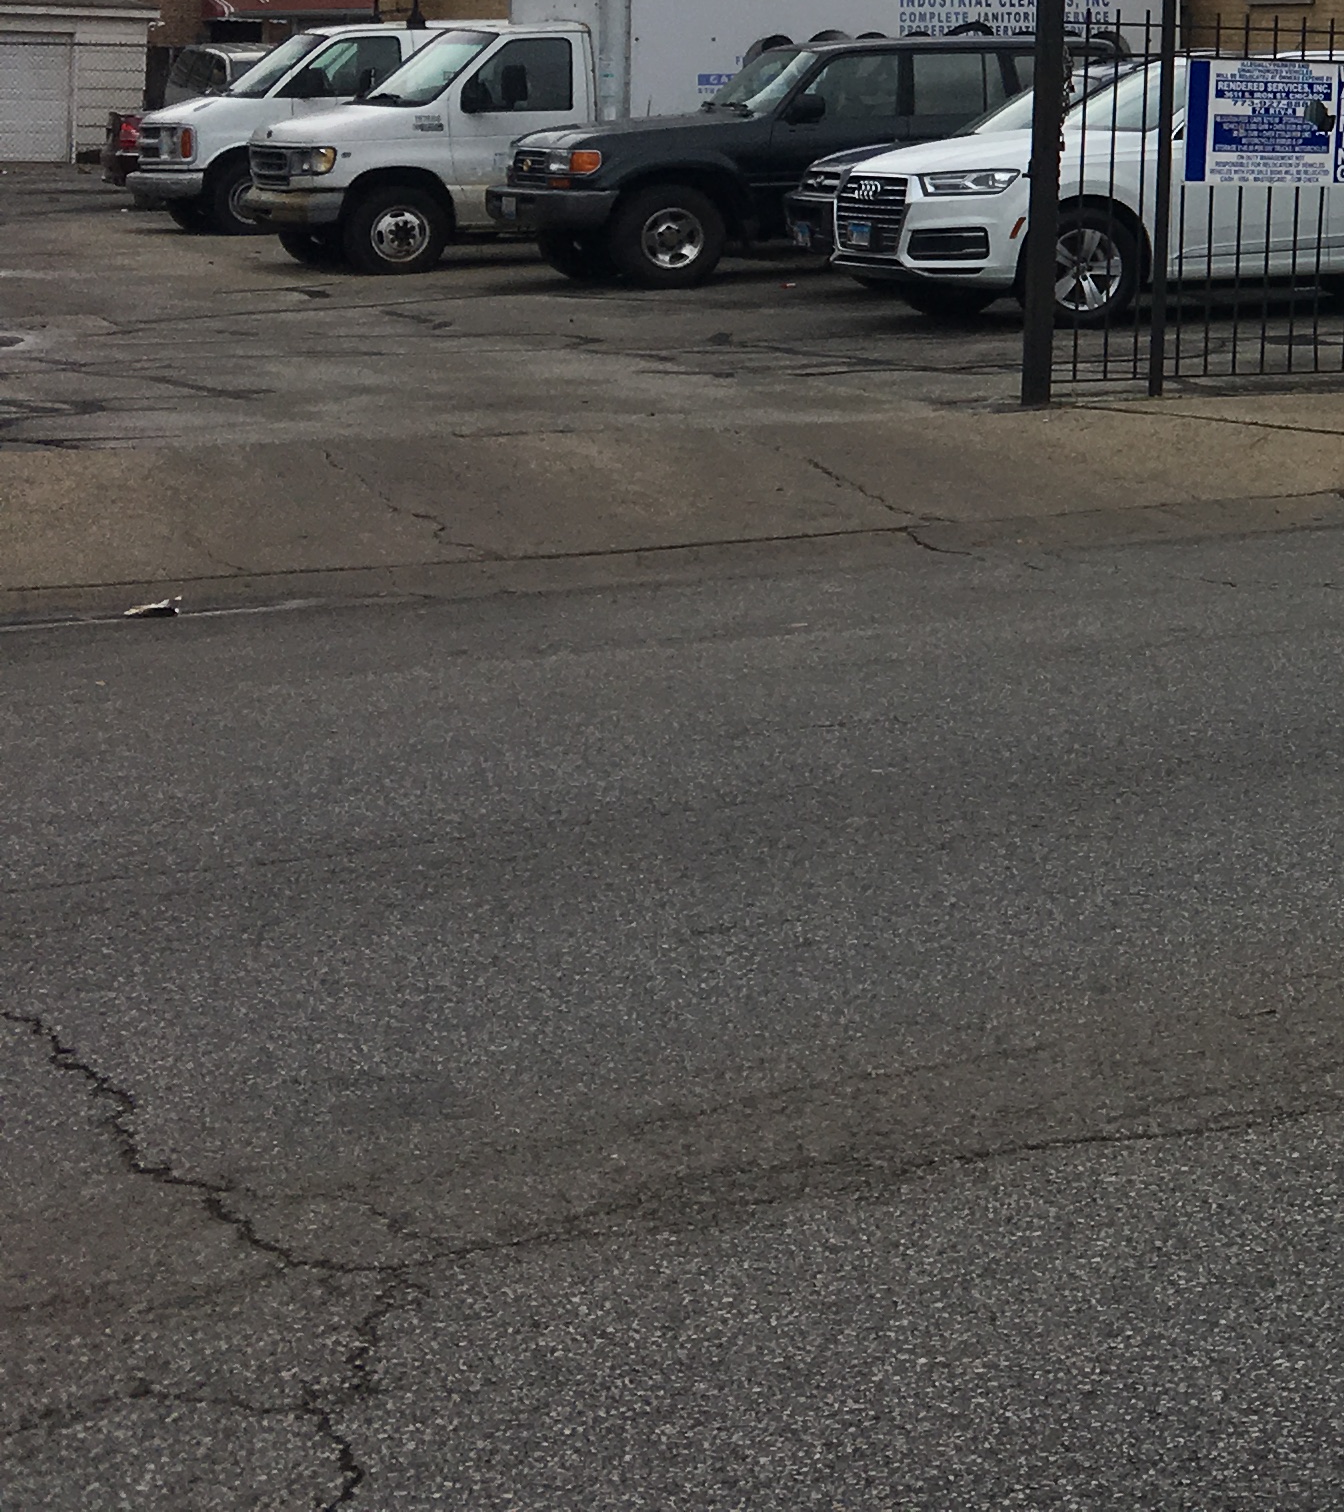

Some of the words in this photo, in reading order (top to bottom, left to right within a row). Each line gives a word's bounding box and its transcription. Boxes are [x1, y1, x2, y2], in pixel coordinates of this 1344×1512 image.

[900, 11, 969, 23] COMPLETE
[976, 12, 1036, 24] JANITORI
[1217, 81, 1265, 91] RENDERED
[1266, 82, 1310, 93] SERVICES,
[1231, 99, 1310, 108] 773-927-888
